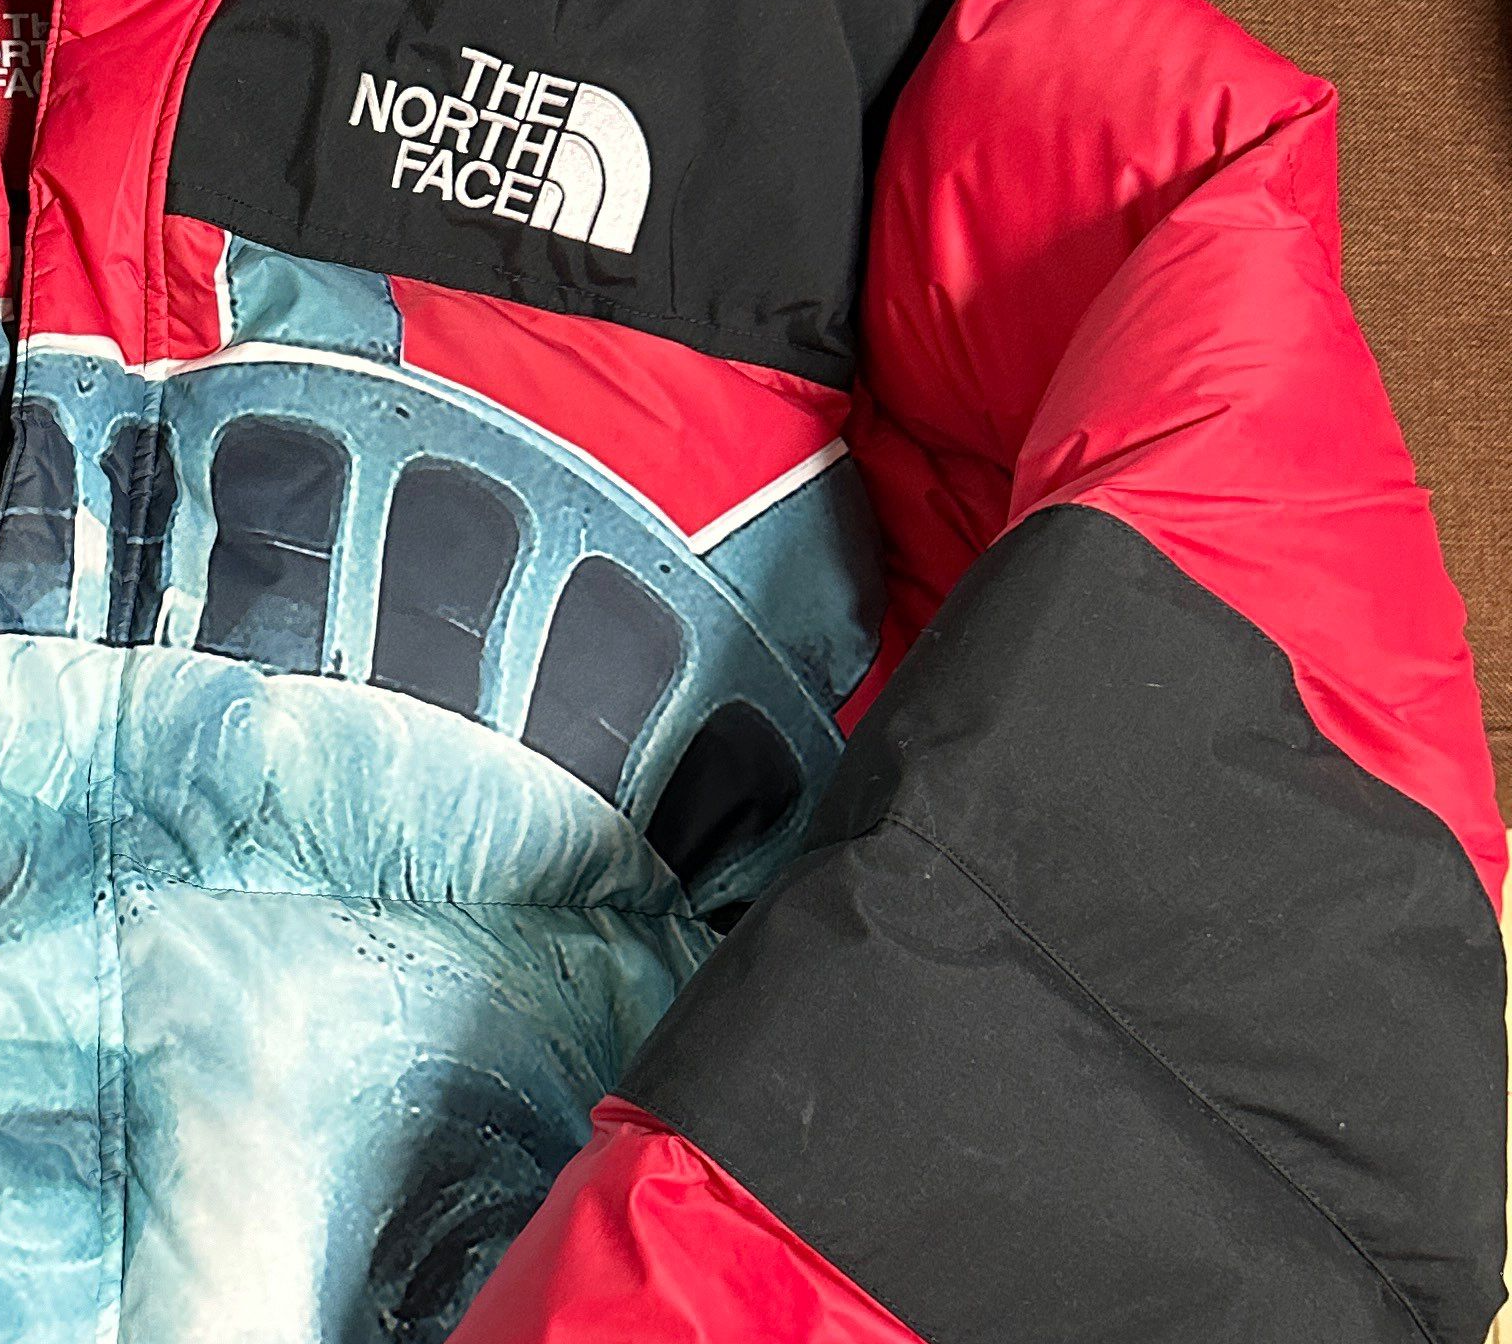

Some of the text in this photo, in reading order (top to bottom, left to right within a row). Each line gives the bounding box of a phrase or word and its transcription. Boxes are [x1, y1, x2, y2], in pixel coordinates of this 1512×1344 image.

[348, 72, 558, 178] NORTH
[461, 46, 577, 128] THE
[391, 139, 543, 224] FACE
